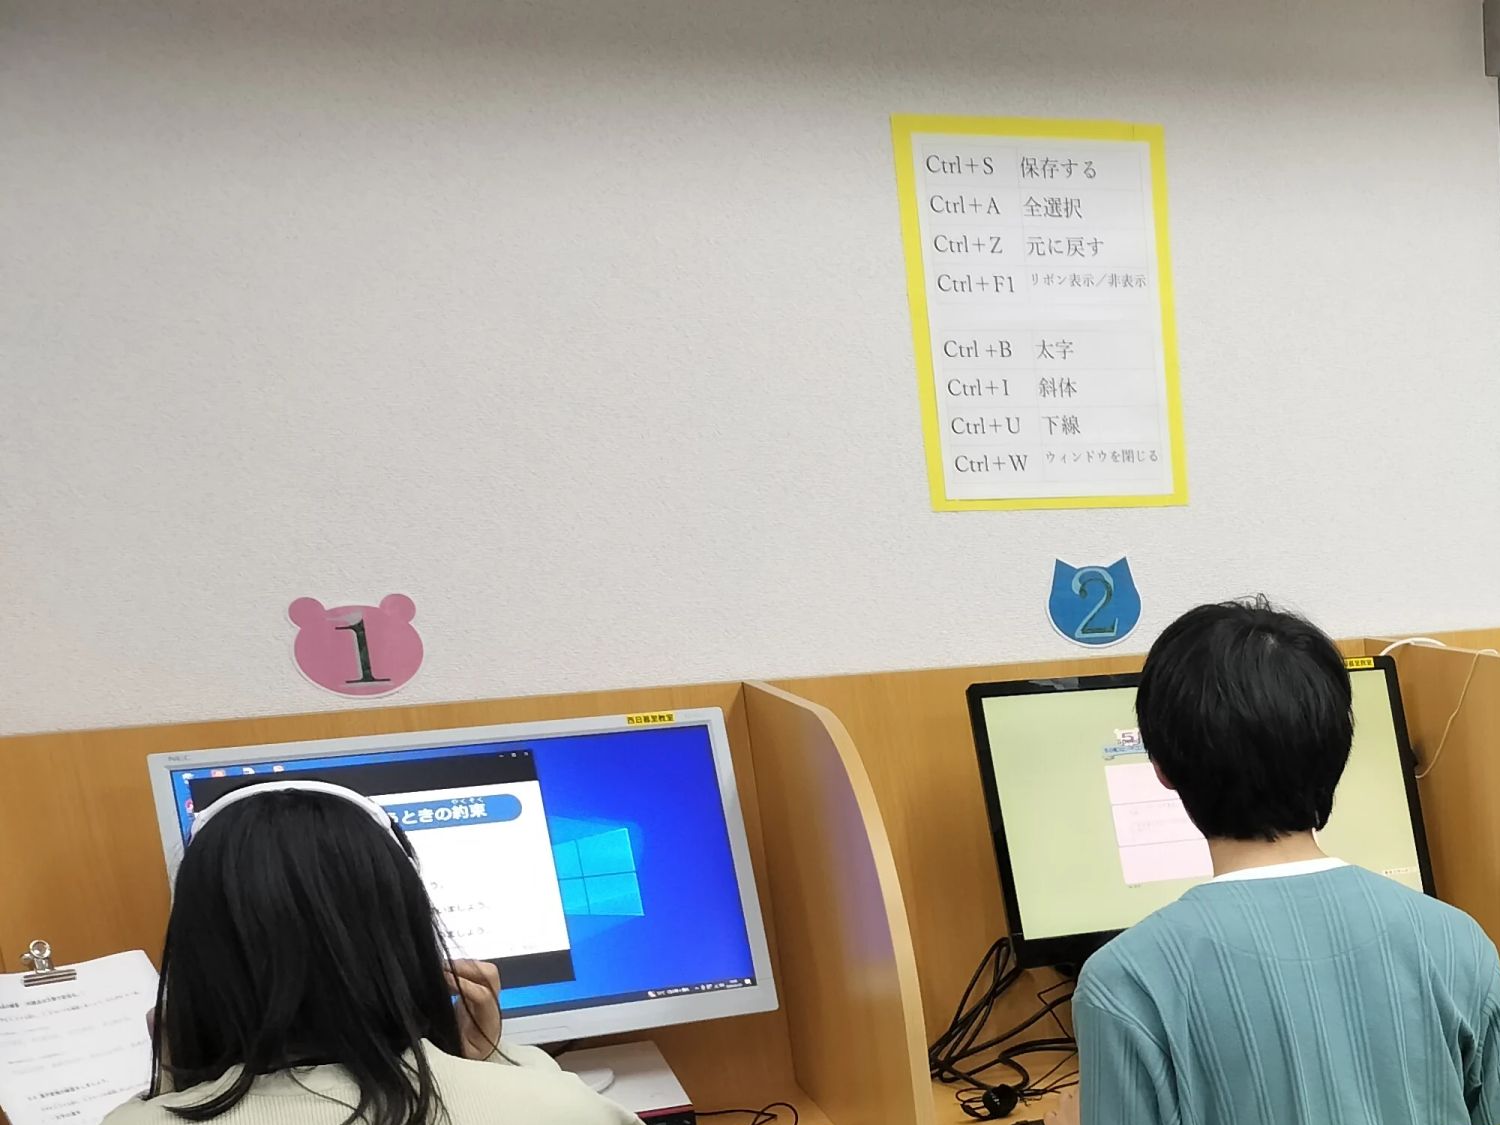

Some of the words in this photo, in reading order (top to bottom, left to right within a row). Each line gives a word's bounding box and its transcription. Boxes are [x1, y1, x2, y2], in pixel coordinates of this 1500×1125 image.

[925, 154, 994, 176] Ctrl+S
[1020, 156, 1097, 180] 保存する
[929, 194, 1001, 216] Ctrl+A
[1023, 195, 1083, 219] 全選択
[933, 234, 1004, 255] Ctrl+Z
[1026, 235, 1104, 257] 元に戻す
[937, 273, 1016, 294] Ctrl+F1
[1035, 338, 1075, 361] 太字
[947, 378, 1010, 397] Ctrl+I
[1038, 376, 1078, 399] 斜体
[951, 416, 1021, 435] Ctrl+U
[1041, 414, 1081, 436] 下線
[954, 454, 1028, 473] Ctrl+W
[1072, 567, 1118, 638] 2
[333, 616, 393, 685] 1
